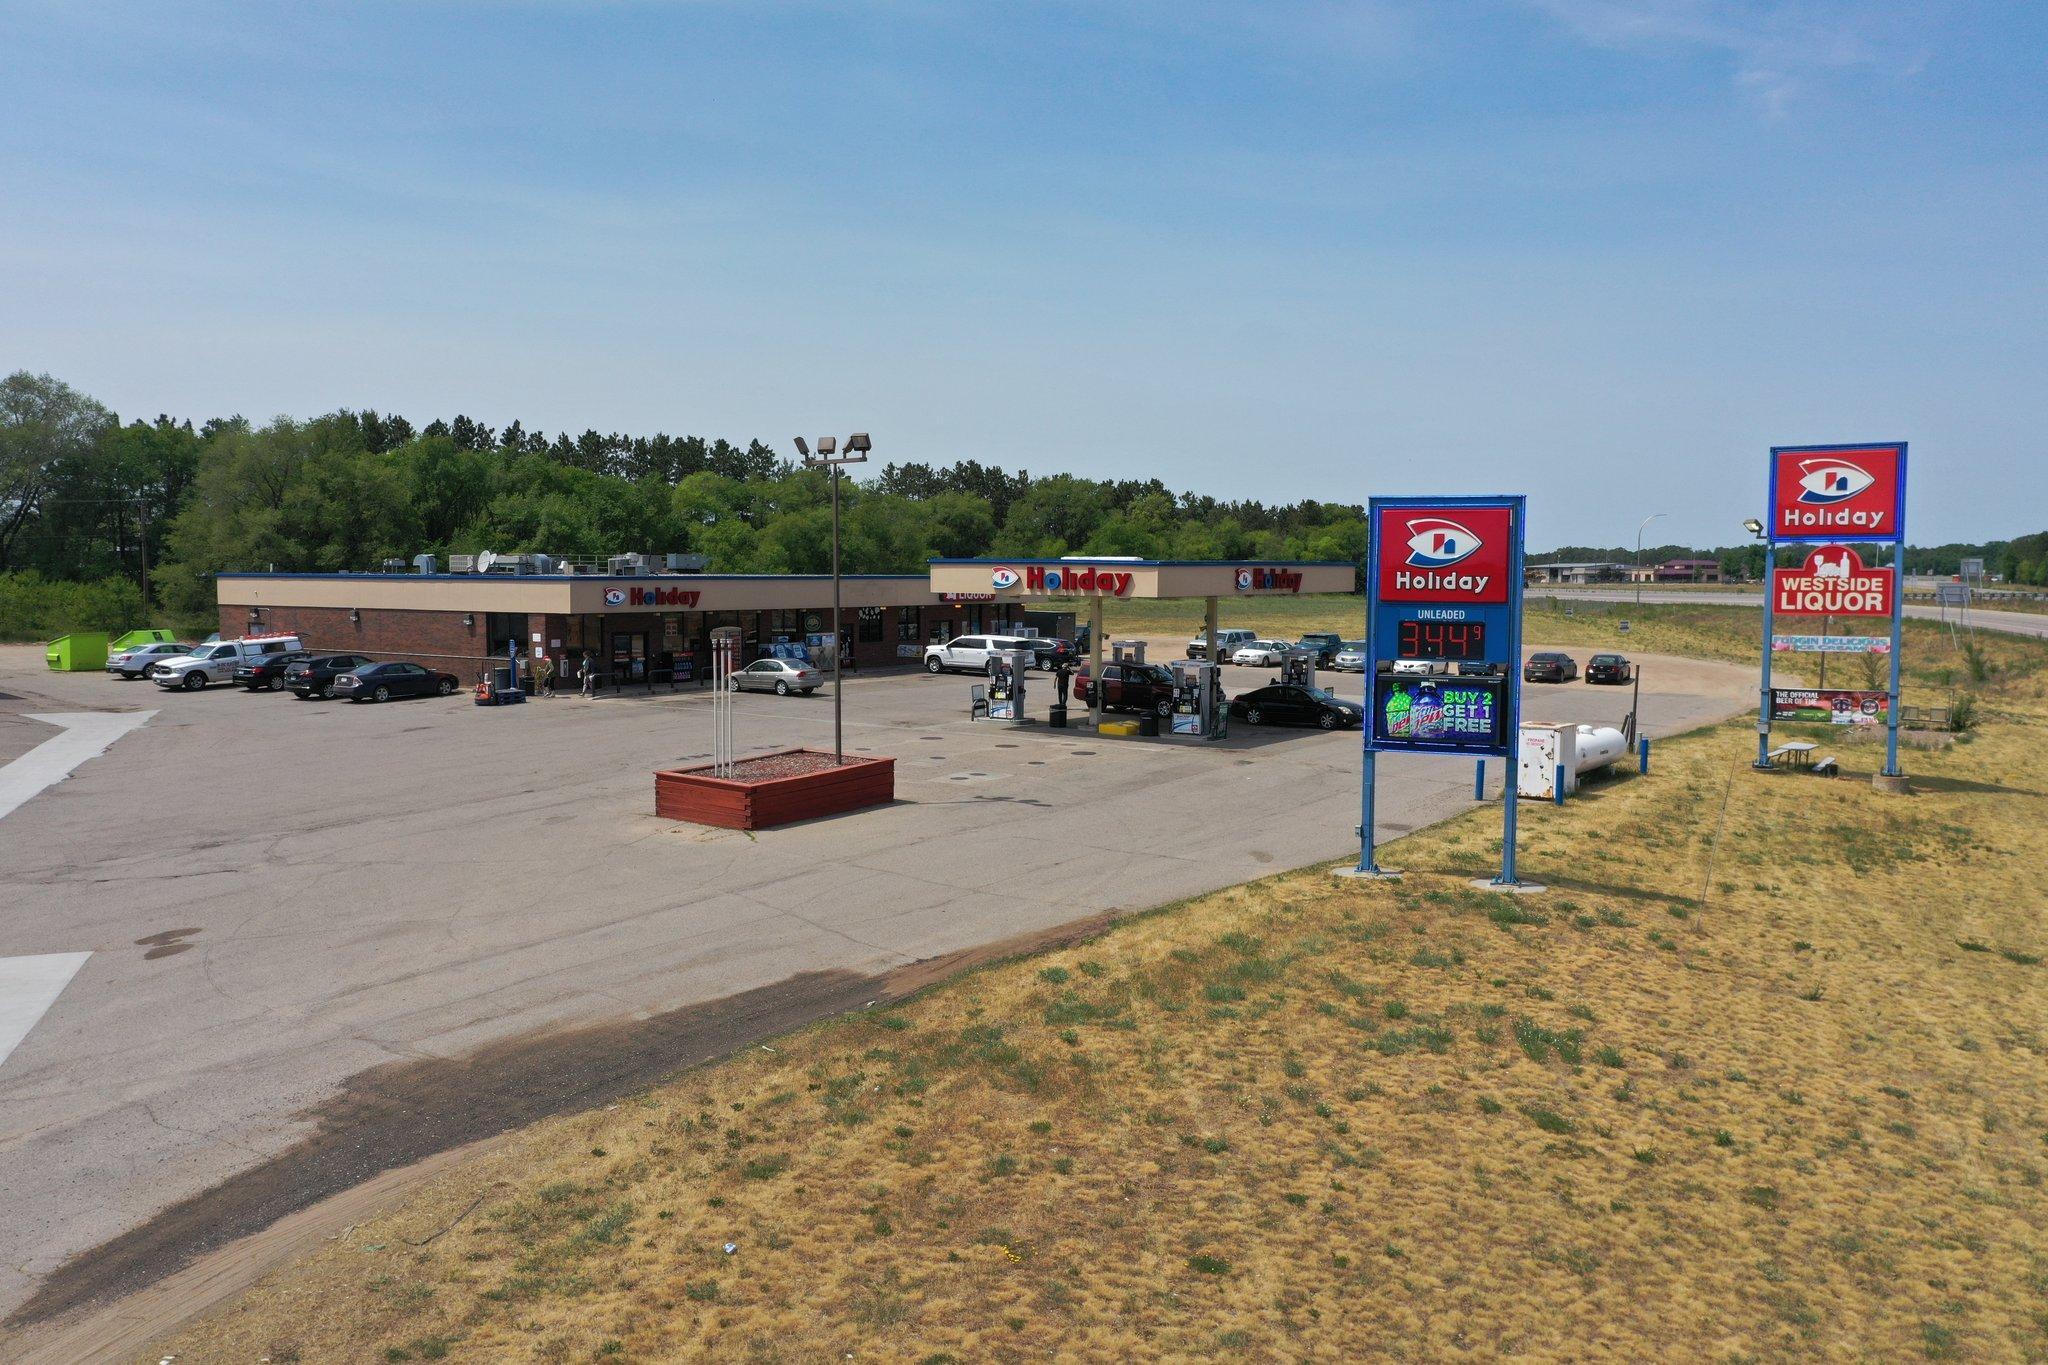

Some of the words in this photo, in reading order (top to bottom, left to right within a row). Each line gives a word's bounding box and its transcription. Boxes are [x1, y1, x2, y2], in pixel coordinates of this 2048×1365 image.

[1785, 508, 1884, 528] Holiday
[1026, 565, 1133, 596] Holiday
[1252, 567, 1303, 593] Holiday
[1396, 572, 1489, 594] Holiday
[1782, 577, 1883, 591] WESTSIDE
[630, 587, 701, 608] Holiday
[1781, 592, 1883, 611] LIQUOR
[1417, 609, 1465, 620] UNLEADED
[1443, 691, 1479, 704] BUY
[1482, 692, 1493, 704] 2
[1790, 691, 1819, 699] OFFICIAL
[1443, 704, 1478, 717] GET
[1483, 706, 1490, 718] 1
[1443, 718, 1491, 733] FREE
